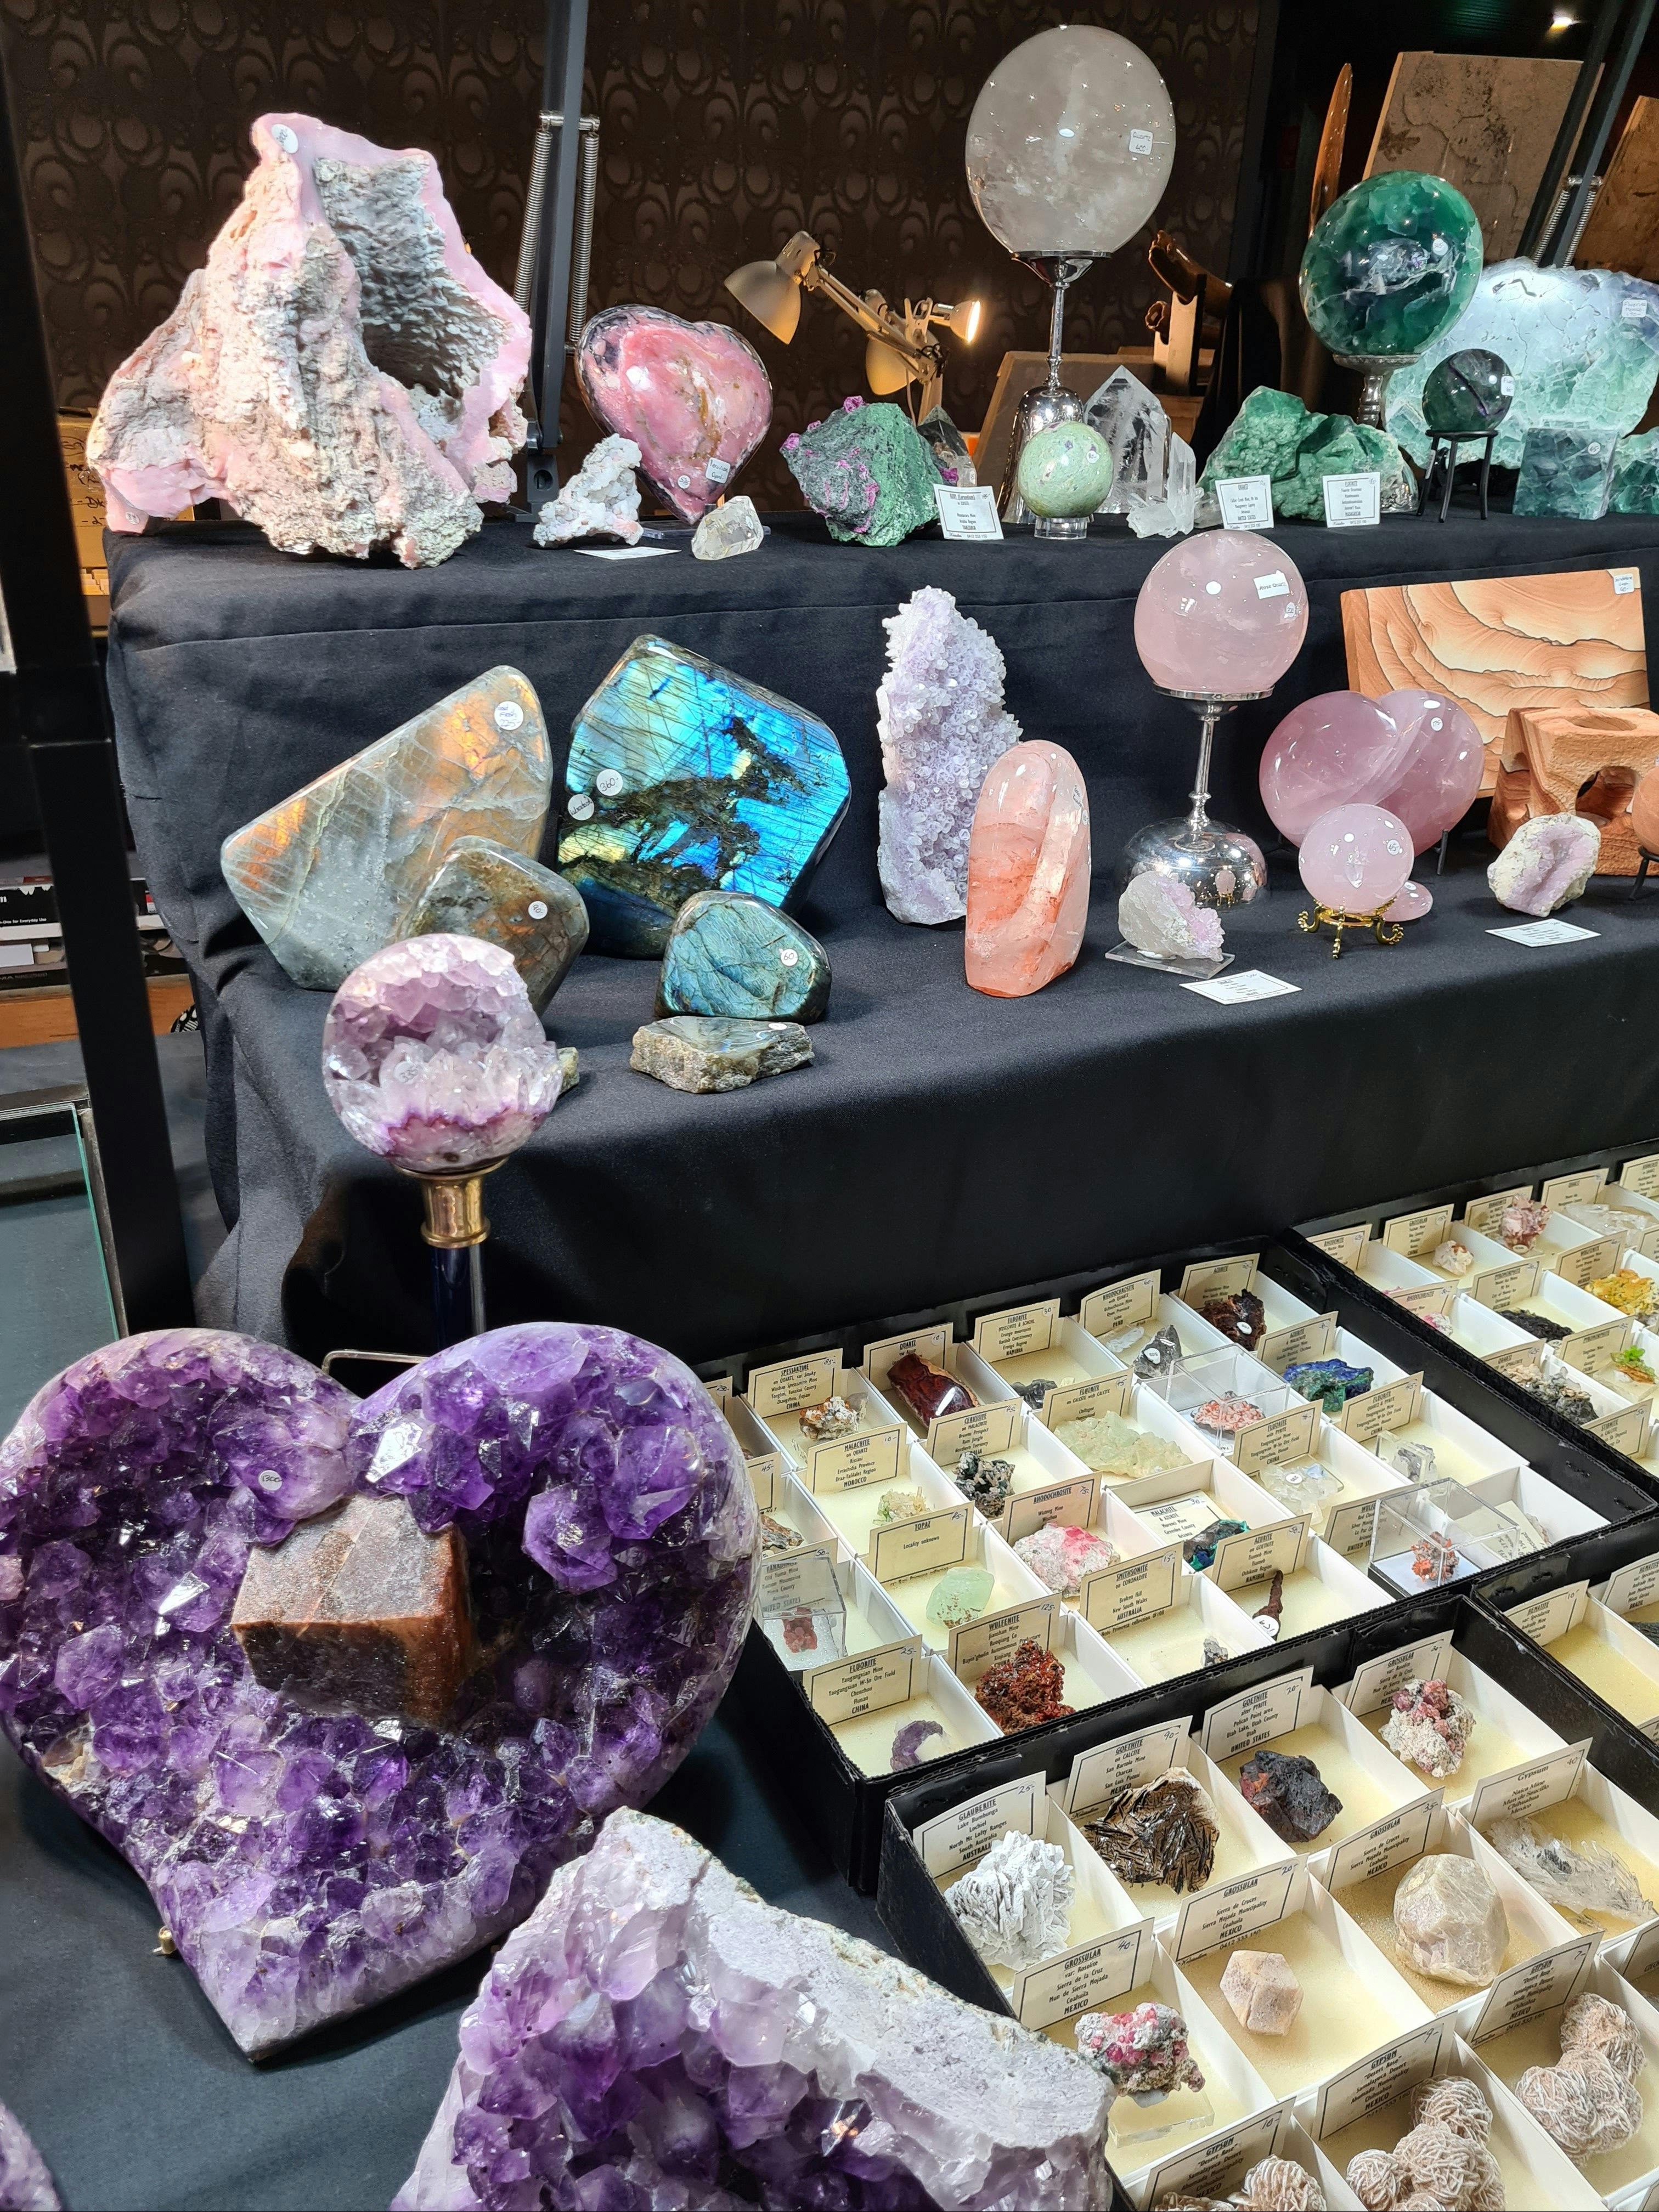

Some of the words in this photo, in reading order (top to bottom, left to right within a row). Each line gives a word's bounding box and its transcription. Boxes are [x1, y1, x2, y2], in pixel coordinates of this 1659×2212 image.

[600, 777, 619, 791] 360-
[784, 952, 794, 960] 60
[899, 1340, 916, 1350] QUARTZ
[781, 1364, 809, 1376] SPESSARTINE
[844, 1438, 870, 1452] MALACHITE
[853, 1447, 867, 1456] QUARTZ
[844, 1476, 867, 1487] MOROCCO
[1034, 1487, 1072, 1504] RHODOCHROSITE
[1150, 1506, 1177, 1517] MALACHITE
[915, 1520, 931, 1532] TOPAZ
[921, 1536, 940, 1544] unknown
[1116, 1564, 1148, 1581] SMITHSONITE
[1245, 1572, 1265, 1583] NAMIBIA
[1119, 1594, 1133, 1603] Broken
[1117, 1606, 1142, 1621] AUSTRALIA
[989, 1615, 1020, 1632] WULFENITE
[850, 1658, 877, 1673] FLUORITE
[851, 1687, 872, 1697] Chenzhou
[1286, 1685, 1299, 1695] 20-
[1242, 1691, 1268, 1708] GOETHITE
[1252, 1700, 1267, 1711] PYRITE
[852, 1704, 869, 1714] CHINA
[1227, 1730, 1237, 1738] Utah
[1263, 1713, 1278, 1722] County
[1234, 1717, 1249, 1727] Pelican
[1250, 1712, 1262, 1720] Point
[1164, 1731, 1180, 1740] 90-
[1231, 1740, 1250, 1752] UNITED
[1252, 1730, 1271, 1744] STATES
[1115, 1739, 1143, 1755] GOETHITE
[1123, 1749, 1140, 1760] CALCITE
[1115, 1768, 1132, 1777] Charcas
[1517, 1766, 1549, 1781] Gypsum
[1018, 1785, 1035, 1795] 25-
[1110, 1783, 1131, 1795] MEXICO
[1530, 1780, 1545, 1789] Mine
[1423, 1802, 1438, 1813] 35-
[1502, 1798, 1518, 1807] Mun
[1508, 1795, 1539, 1810] Chihuahua
[958, 1798, 996, 1823] GLAUBERITE
[1510, 1804, 1531, 1815] Mexico
[957, 1821, 969, 1830] Lake
[972, 1808, 998, 1823] Bumbunga
[969, 1820, 986, 1832] Lochiel
[1370, 1818, 1400, 1840] GROSSULAR
[949, 1840, 963, 1850] North
[975, 1829, 988, 1838] Lofty
[990, 1820, 1007, 1831] Ranges
[959, 1845, 973, 1853] South
[975, 1832, 997, 1846] Australia
[1364, 1847, 1376, 1856] Sierra
[1386, 1835, 1400, 1845] Cruces
[963, 1842, 992, 1860] AUSTRALI
[1351, 1861, 1363, 1870] Sierra
[1366, 1851, 1381, 1862] Mojada
[1384, 1837, 1409, 1853] Municipality
[1369, 1855, 1388, 1867] Coahuila
[1282, 1864, 1298, 1875] 20-
[1367, 1862, 1387, 1876] MEXICO
[1223, 1879, 1257, 1898] GROSSULAR
[1217, 1906, 1230, 1916] Sierra
[1242, 1897, 1257, 1906] Cruces
[1202, 1920, 1216, 1930] Sierra
[1218, 1913, 1236, 1923] Mojada
[1238, 1900, 1267, 1915] Municipality
[1222, 1917, 1243, 1929] Coahuila
[1220, 1925, 1242, 1939] MEXICO
[1118, 1940, 1135, 1951] 40-
[1064, 1949, 1101, 1971] GROSSULAR
[1078, 1960, 1098, 1972] Rosolite
[1057, 1979, 1071, 1991] Sierra
[1092, 1967, 1103, 1976] Cruz
[1049, 1994, 1060, 2002] Mun
[1072, 1983, 1086, 1994] Sierra
[1090, 1975, 1108, 1986] Mojada
[1066, 1991, 1088, 2004] Coahuila
[1064, 1999, 1088, 2015] MEXICO
[1509, 2007, 1531, 2020] MEXICO
[1370, 2050, 1397, 2070] GYPSUM
[1389, 2062, 1407, 2073] Desert
[1365, 2092, 1390, 2111] MEXICO
[1262, 2118, 1279, 2129] 10-
[1205, 2137, 1234, 2157] GYPSUM
[1224, 2151, 1243, 2162] Desert
